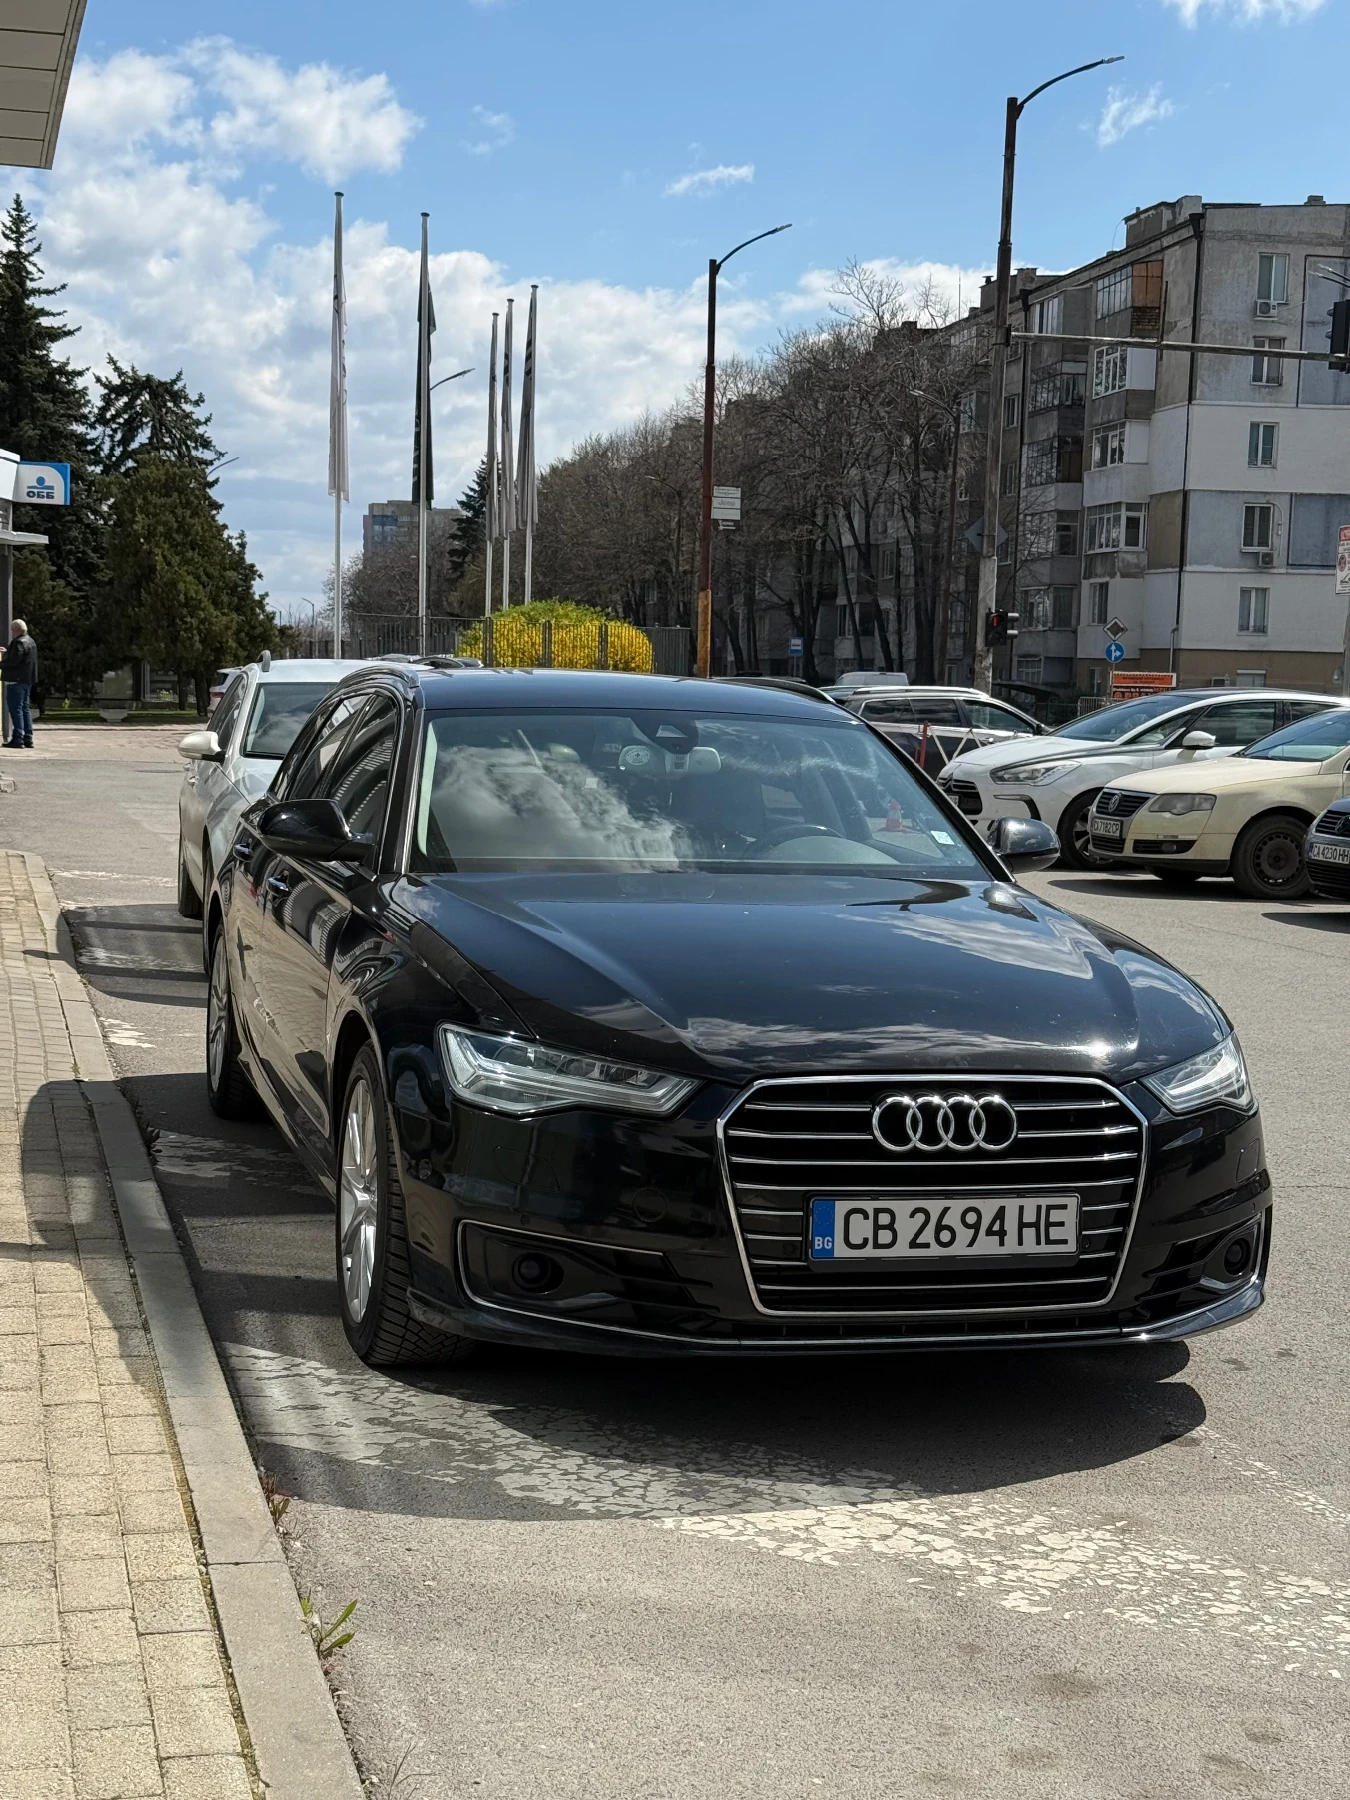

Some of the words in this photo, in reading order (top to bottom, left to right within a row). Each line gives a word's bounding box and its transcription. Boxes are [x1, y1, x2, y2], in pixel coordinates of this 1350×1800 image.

[26, 490, 54, 500] ОББ
[718, 499, 736, 507] Jeep
[843, 1207, 898, 1250] CB
[908, 1205, 1008, 1250] 2694
[1017, 1203, 1069, 1247] HE
[814, 1236, 833, 1250] BG
